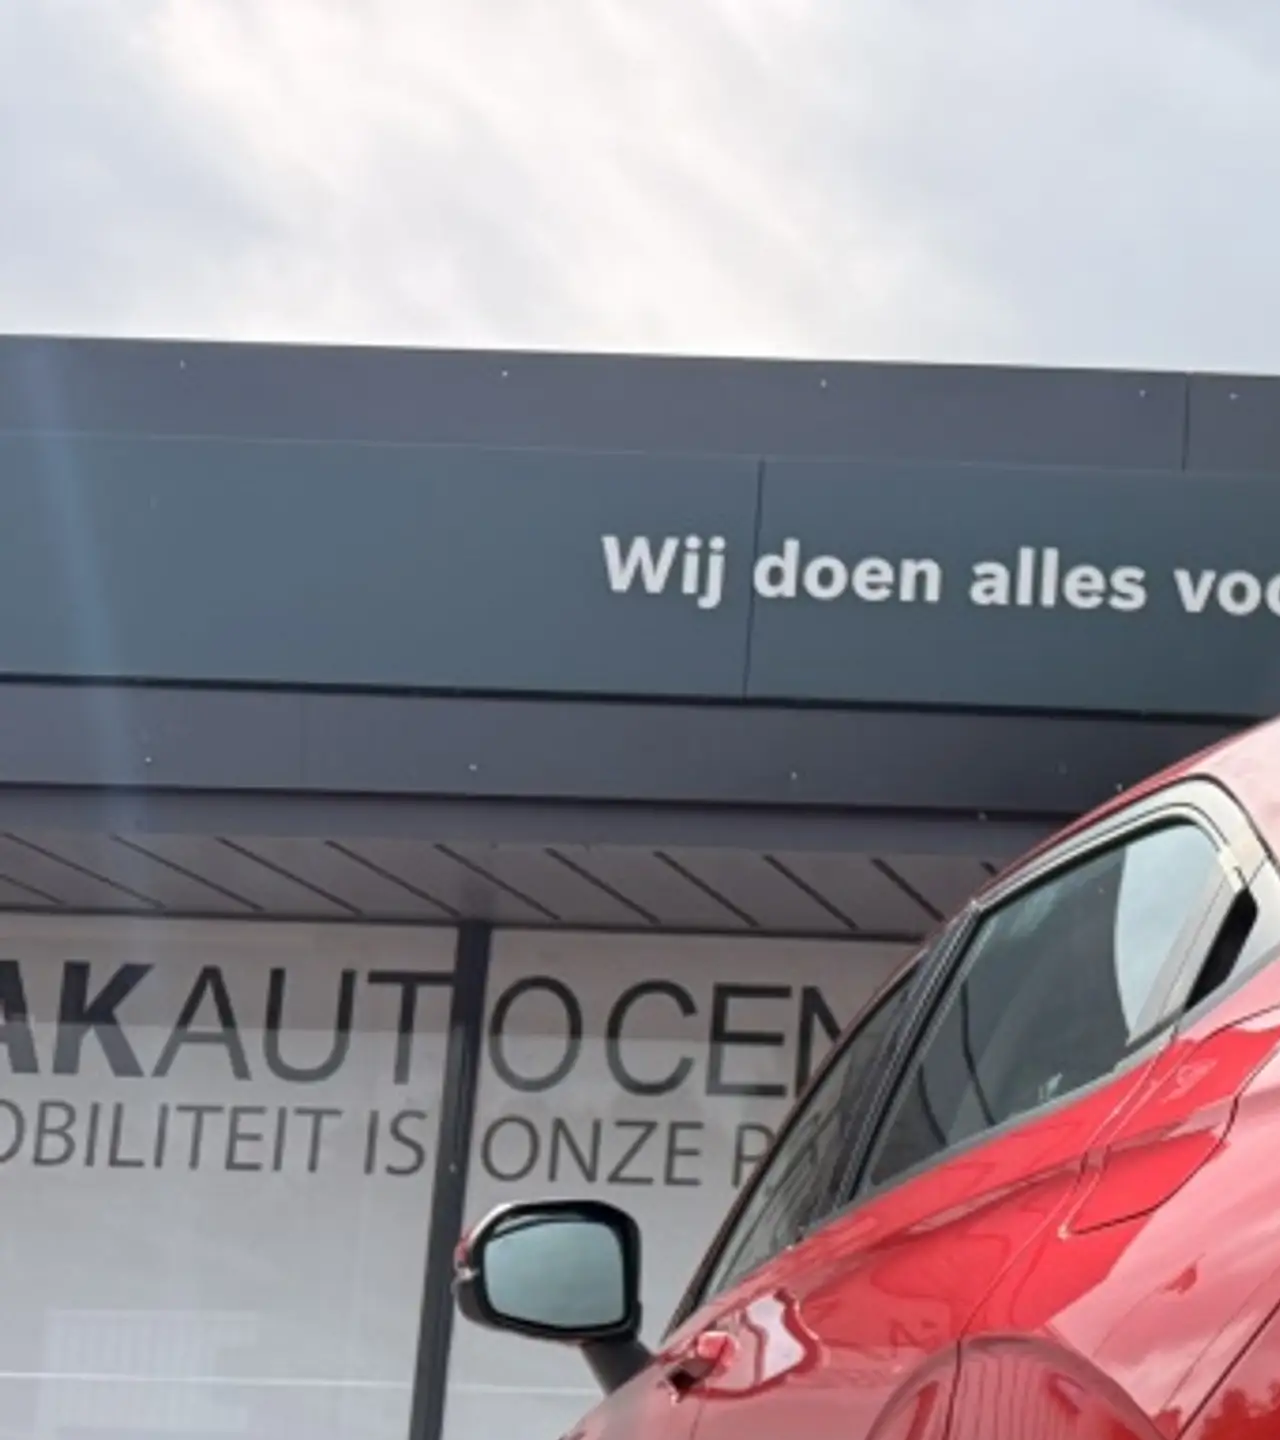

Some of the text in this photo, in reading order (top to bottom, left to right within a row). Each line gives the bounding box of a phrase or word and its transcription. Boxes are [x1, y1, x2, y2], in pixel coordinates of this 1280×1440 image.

[602, 534, 726, 609] Wij
[752, 539, 943, 603] doen
[969, 546, 1147, 611] alles
[364, 1109, 427, 1176] IS
[480, 1115, 704, 1187] ONZE
